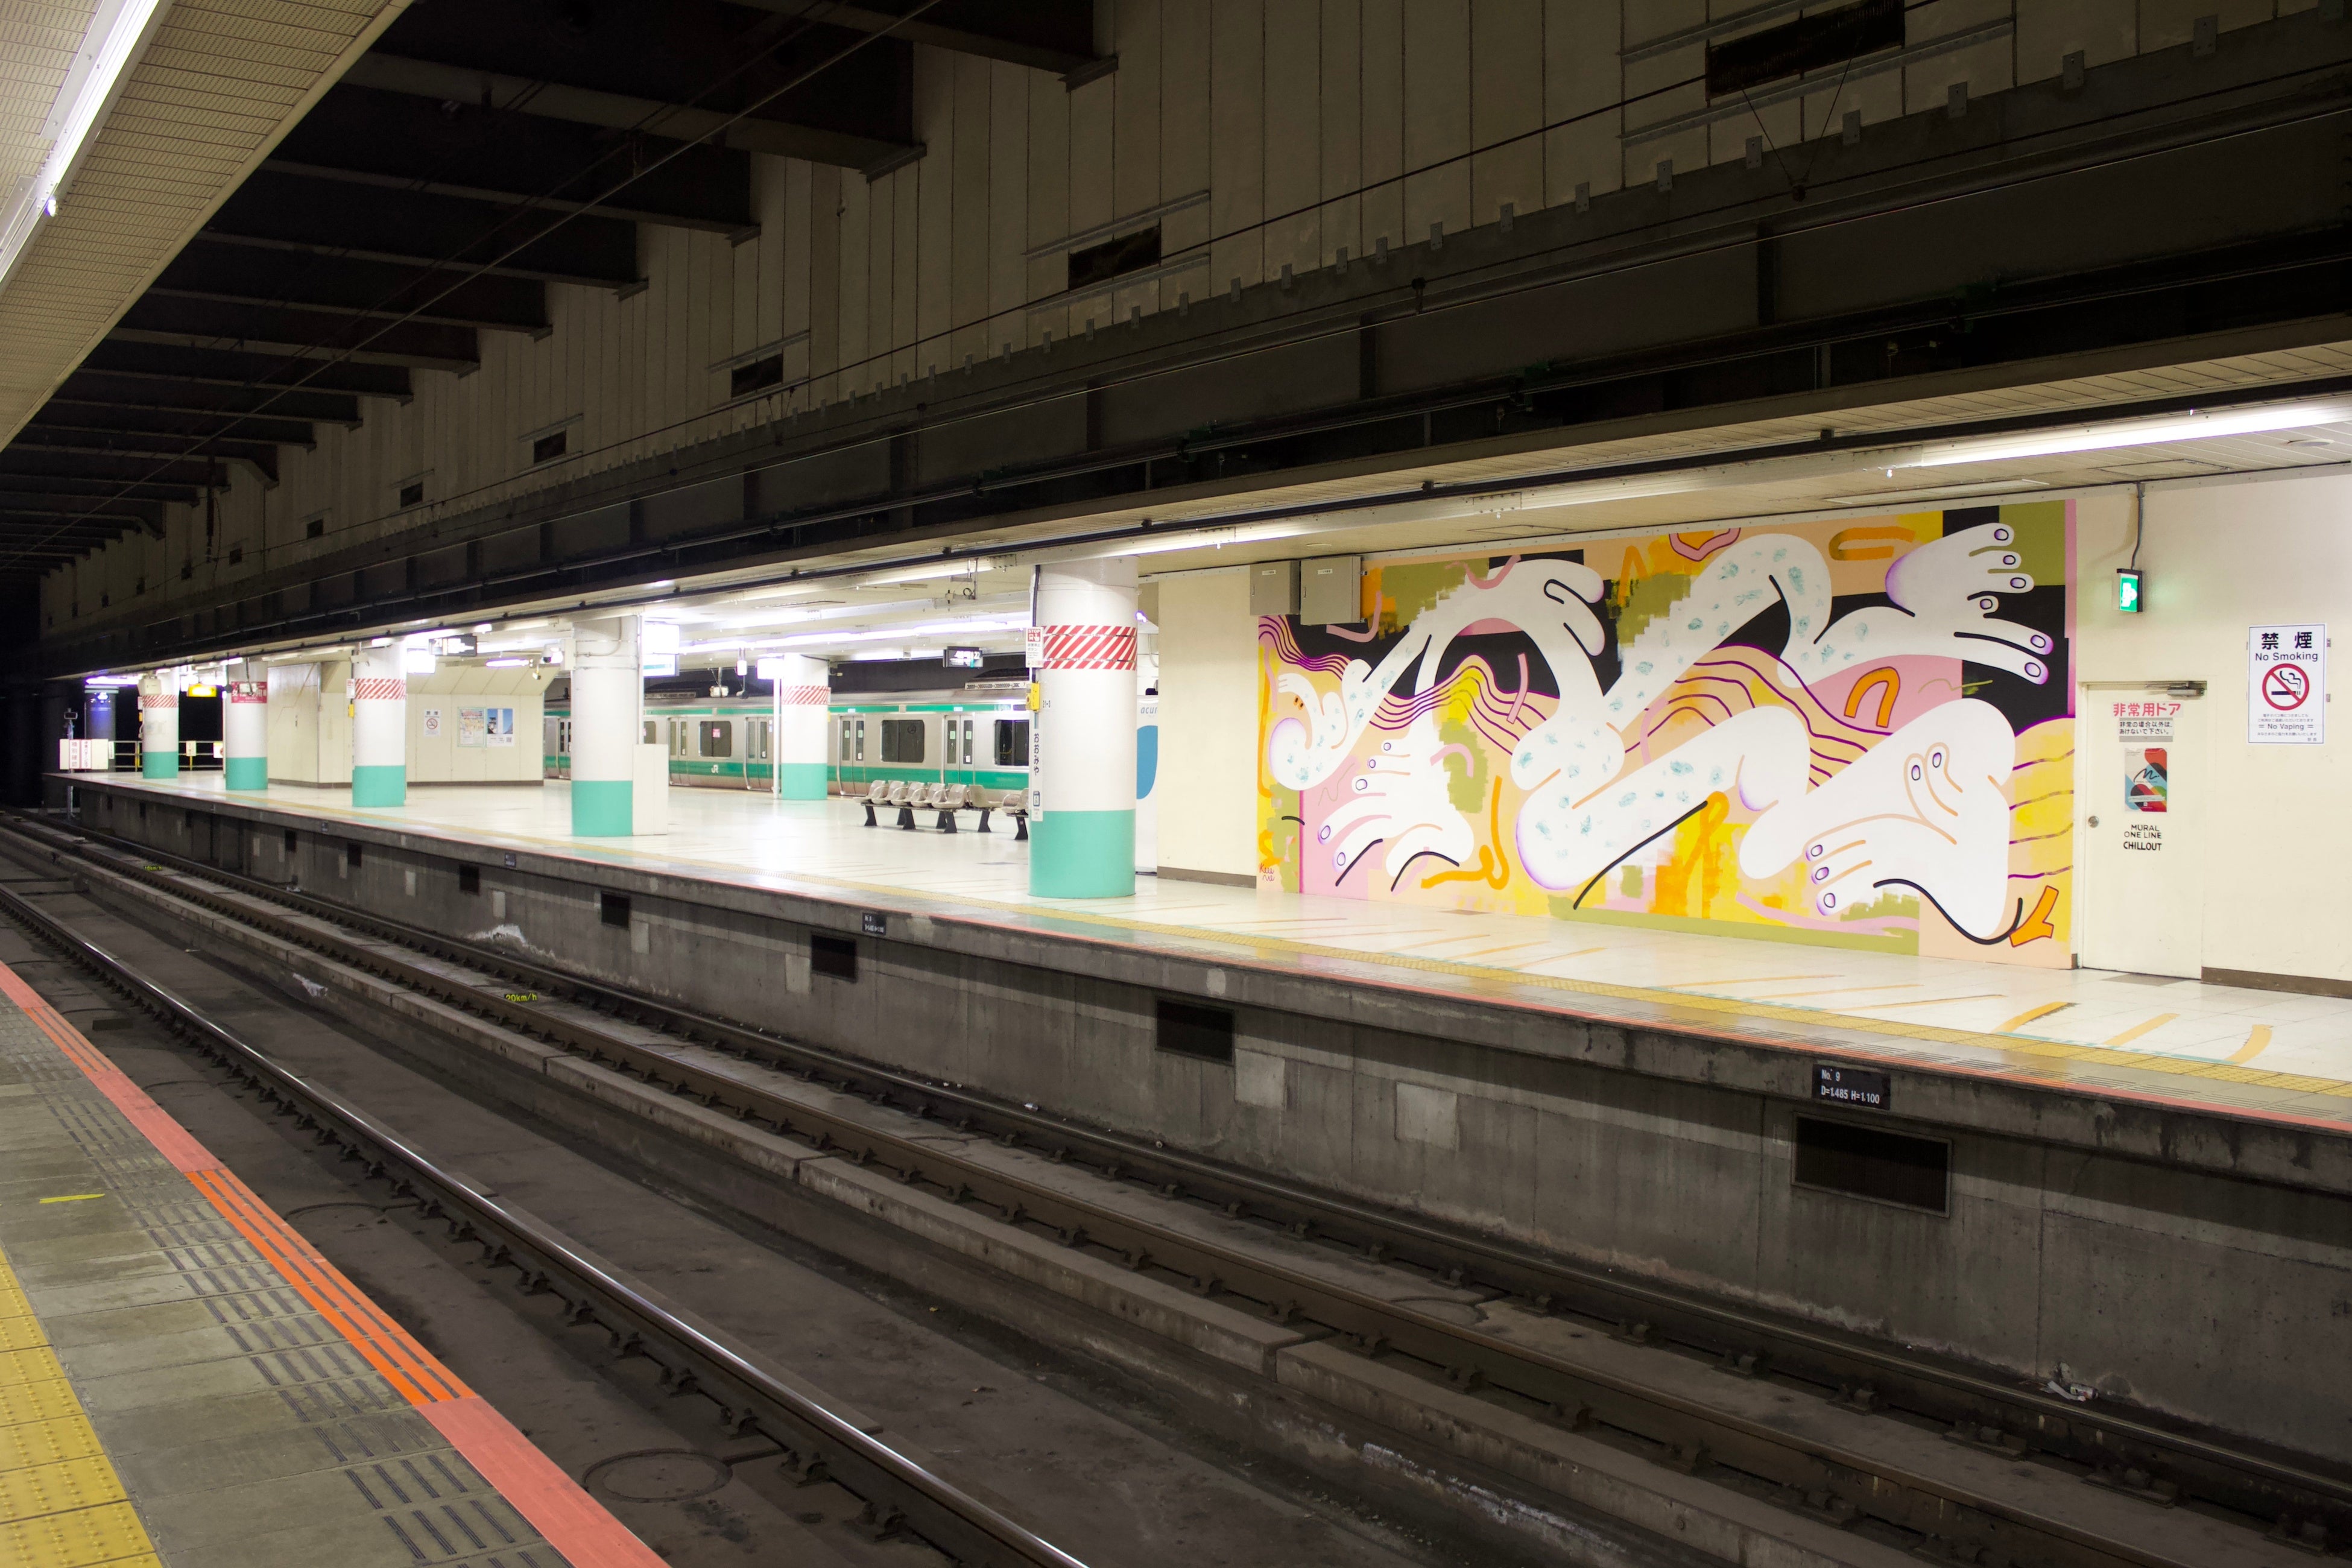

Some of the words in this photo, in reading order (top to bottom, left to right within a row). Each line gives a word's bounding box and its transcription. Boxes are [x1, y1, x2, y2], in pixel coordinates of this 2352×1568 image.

[2256, 653, 2269, 661] No
[2273, 652, 2318, 662] Smoking
[2113, 703, 2181, 716] 非常用ドア
[711, 764, 718, 773] JR
[2123, 841, 2161, 851] CHILLOUT
[1835, 1072, 1840, 1081] 9
[1821, 1086, 1848, 1099] D=1.485
[1851, 1090, 1880, 1104] H=1.100
